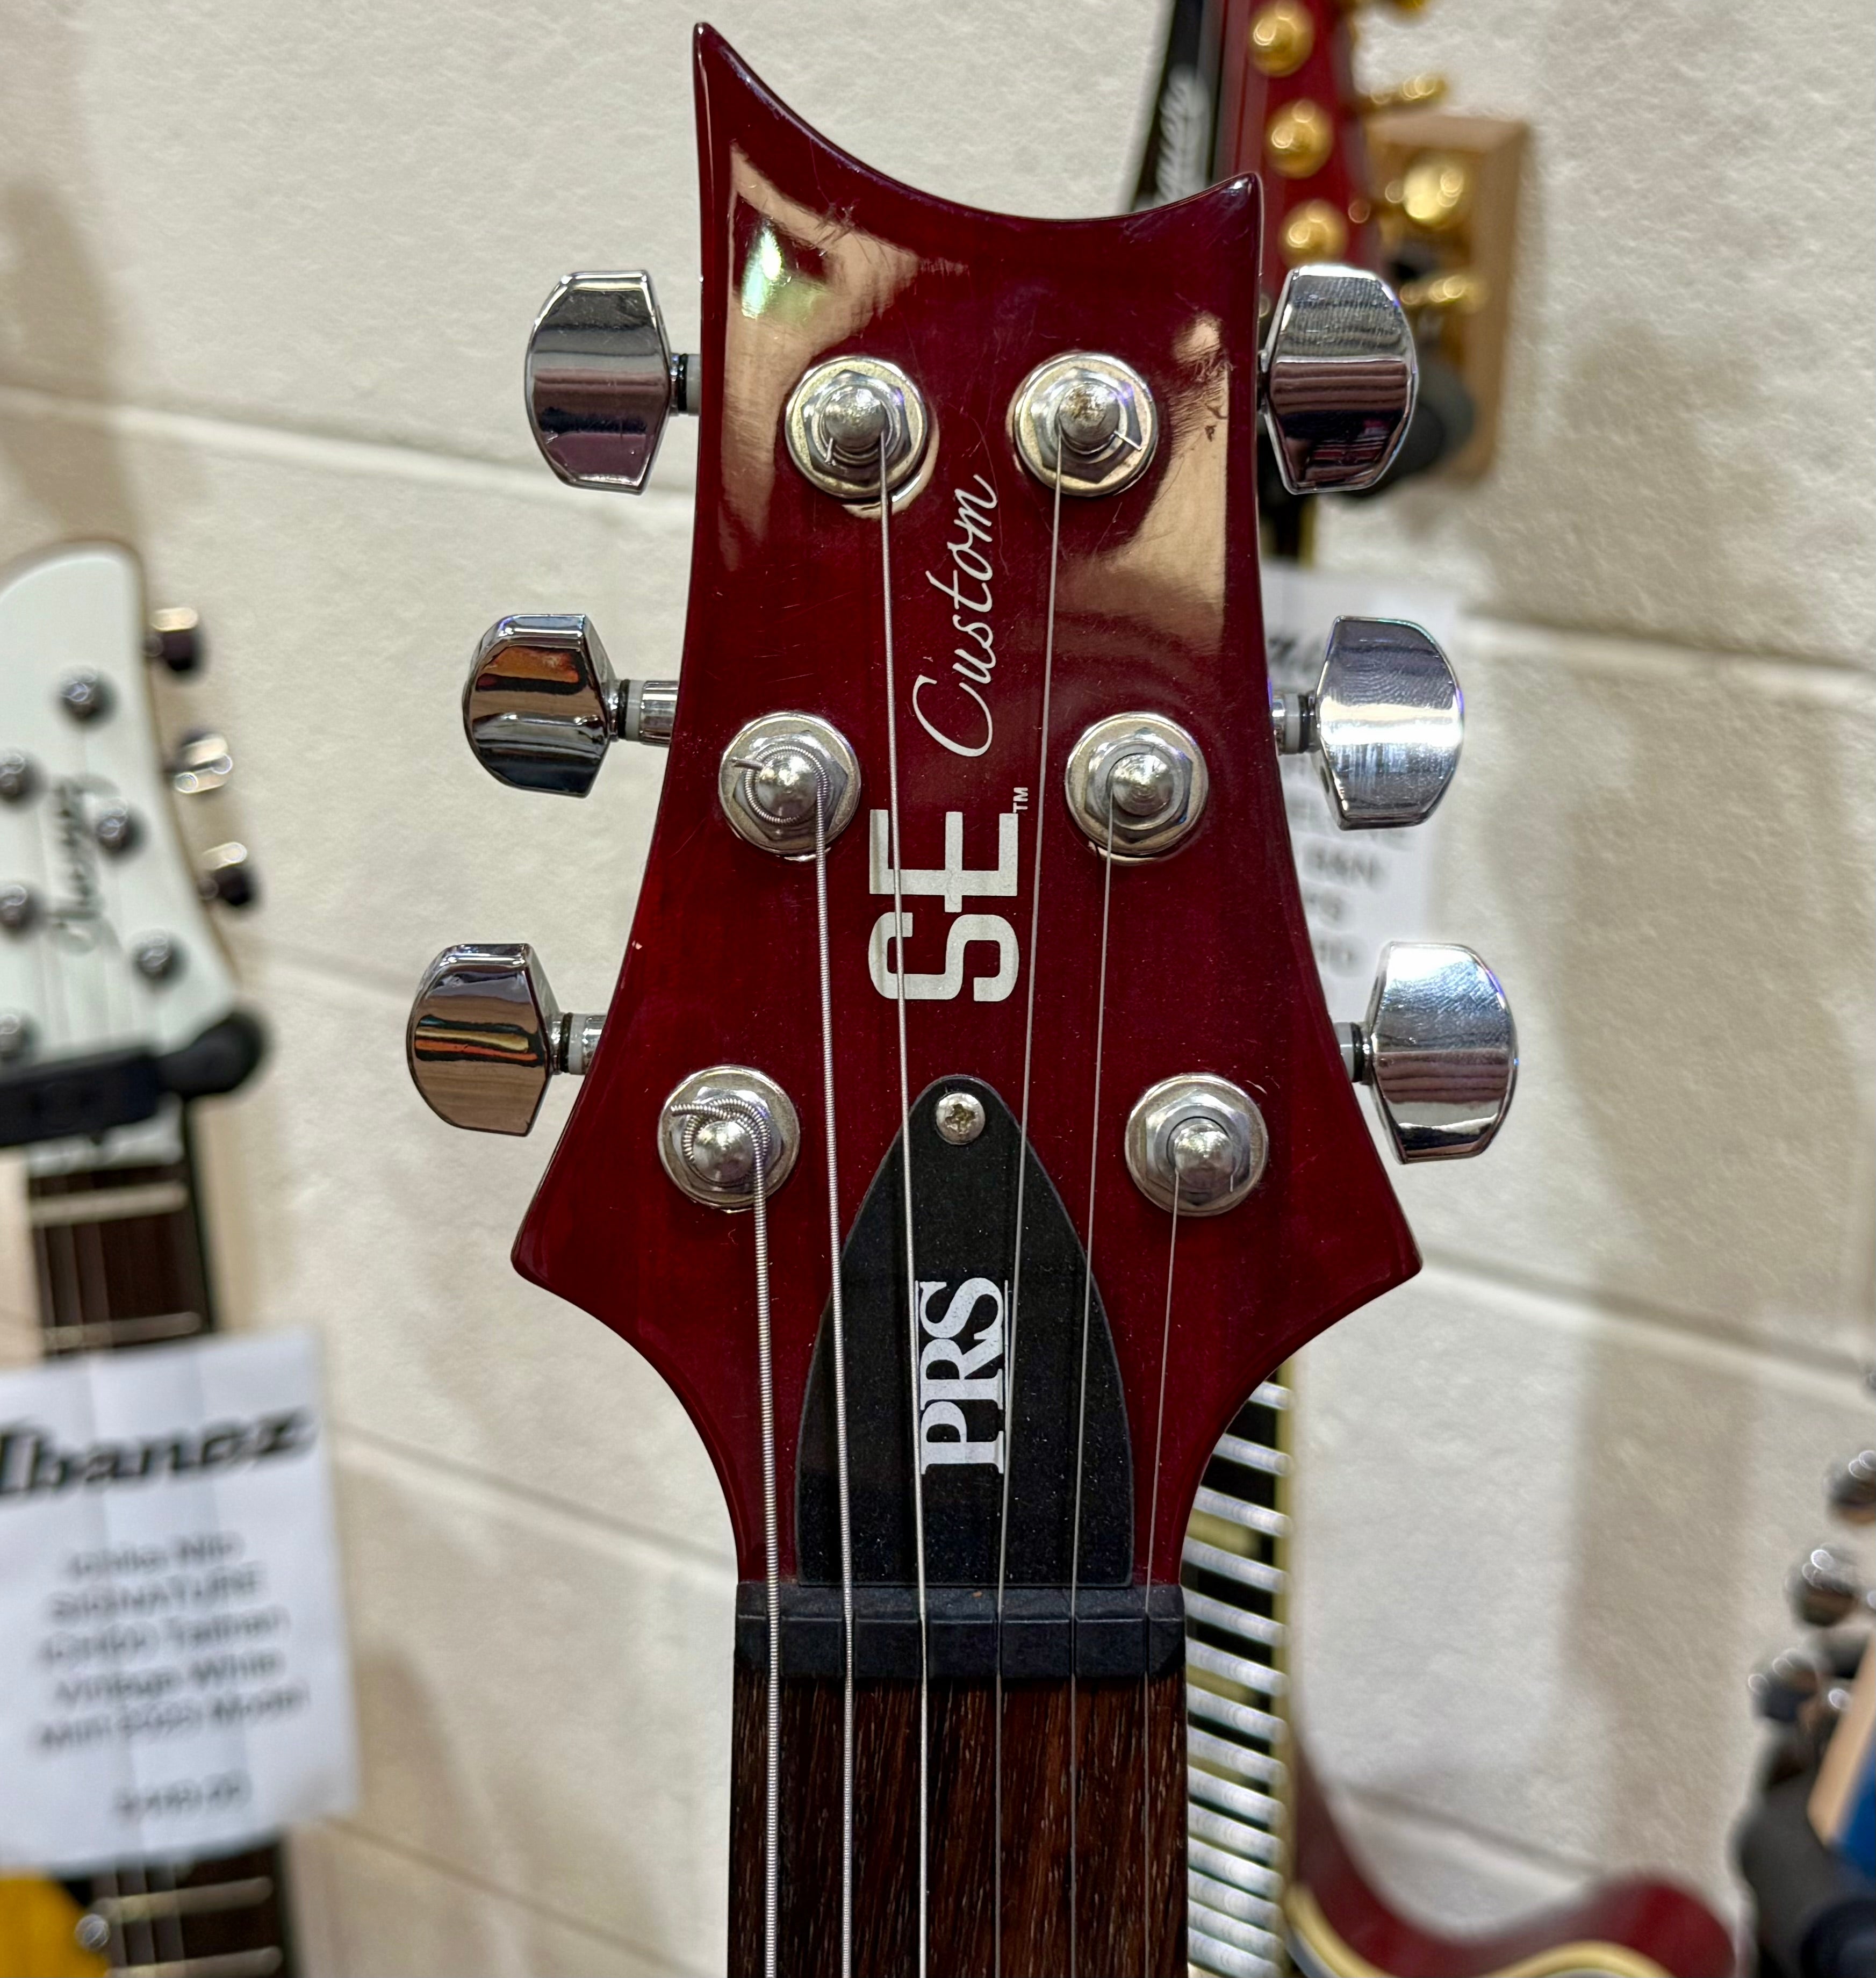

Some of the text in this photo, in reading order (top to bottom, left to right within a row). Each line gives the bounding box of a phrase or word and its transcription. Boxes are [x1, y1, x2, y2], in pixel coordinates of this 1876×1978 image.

[912, 473, 998, 757] Custom
[868, 808, 1019, 1002] SE
[918, 1276, 1004, 1476] PRS
